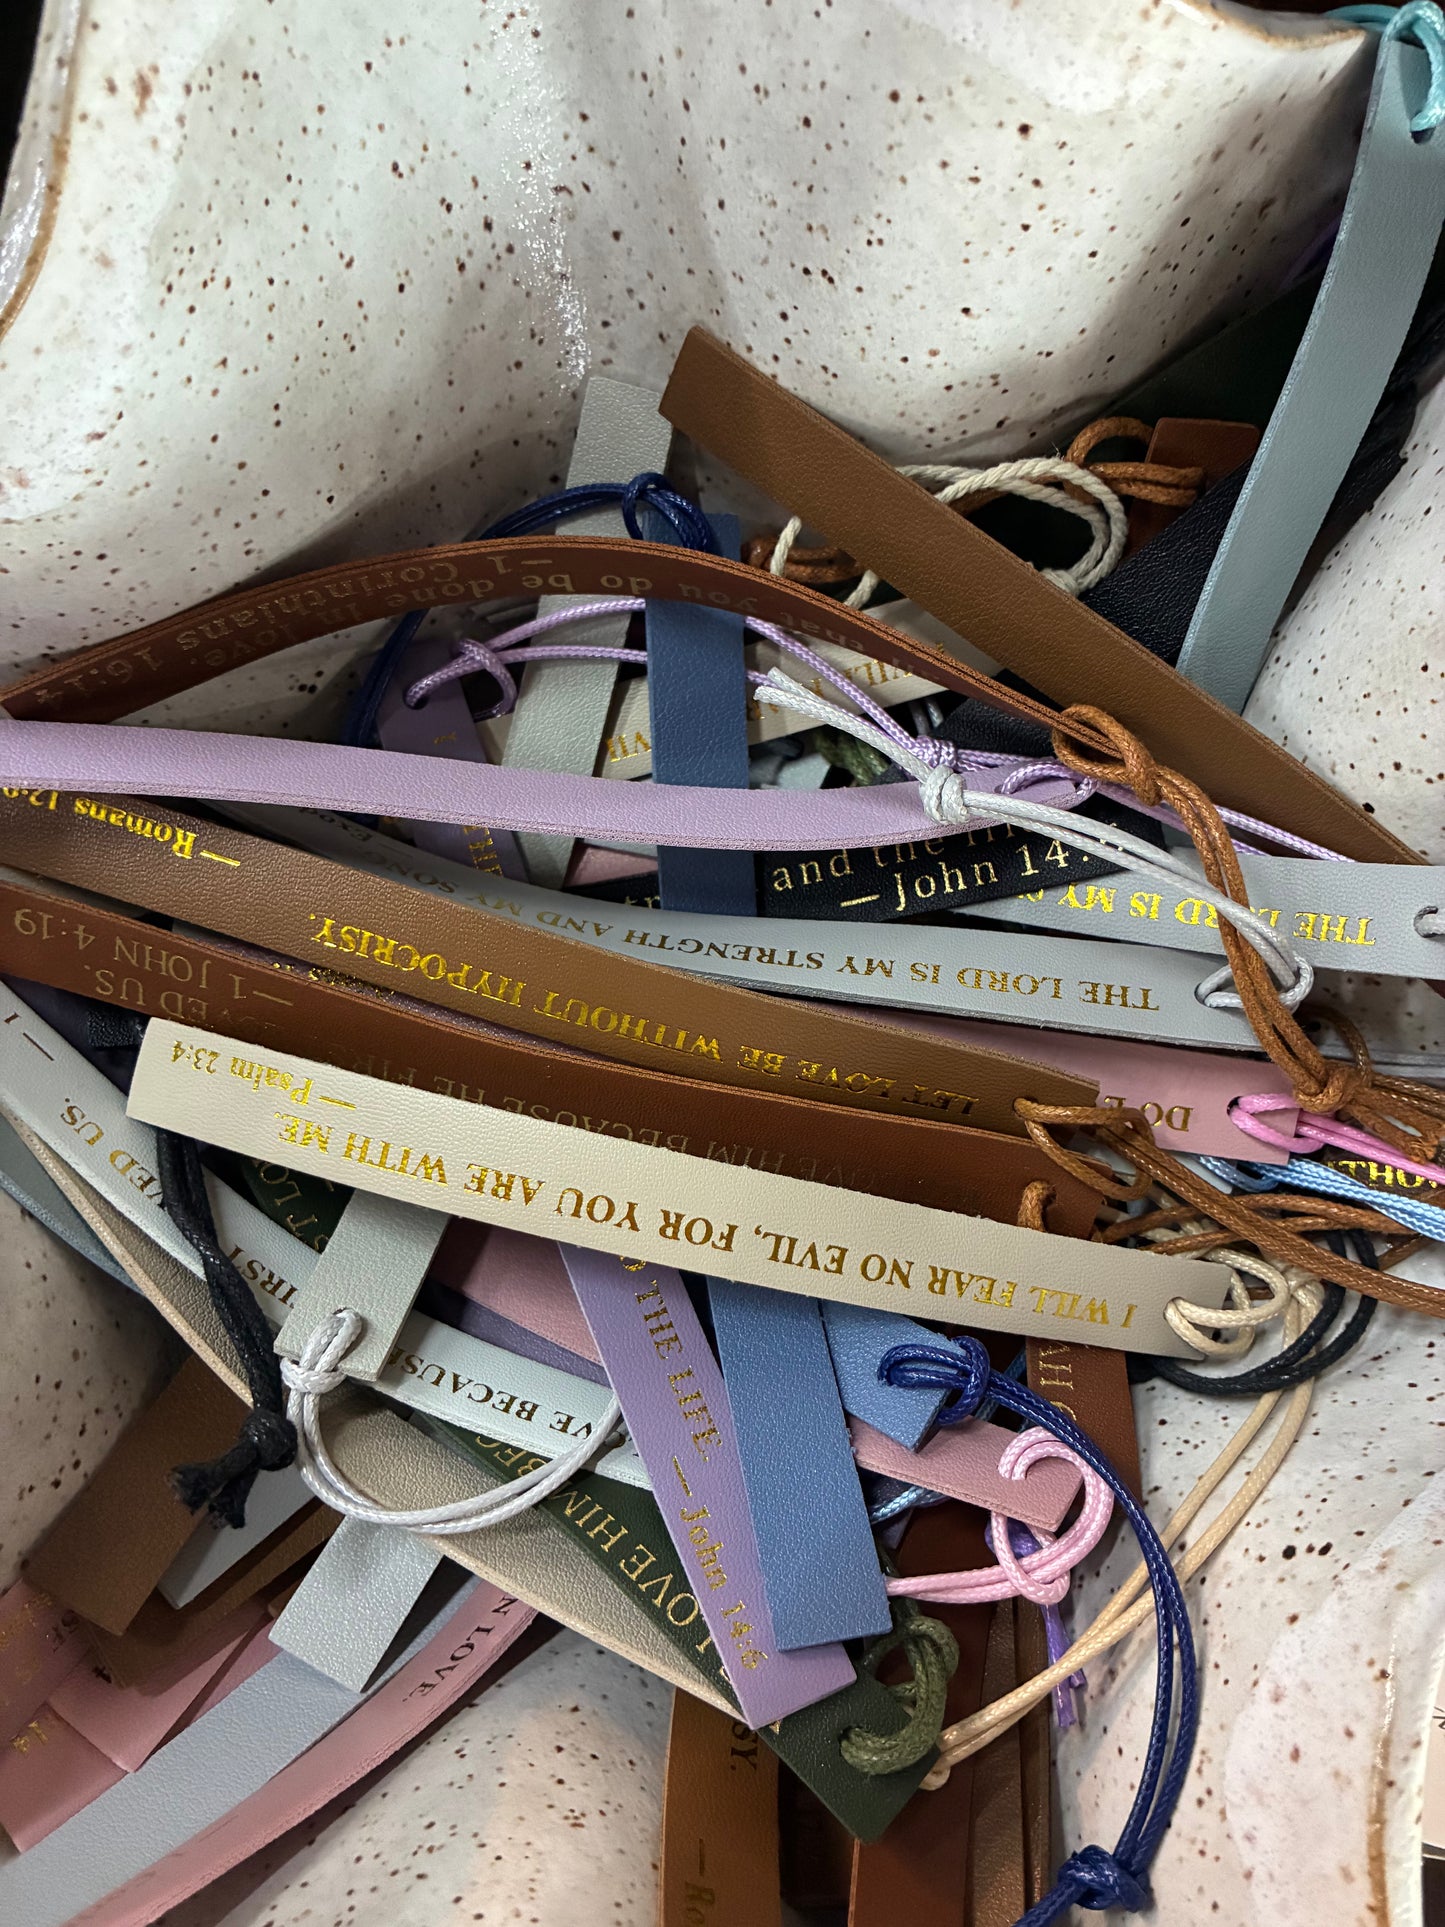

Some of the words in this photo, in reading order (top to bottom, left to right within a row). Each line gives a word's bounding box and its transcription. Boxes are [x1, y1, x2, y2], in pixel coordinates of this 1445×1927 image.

[387, 573, 495, 609] done
[521, 573, 576, 591] be
[600, 574, 652, 593] do
[176, 562, 460, 652] Corinthians
[73, 797, 197, 860] Romans
[773, 850, 852, 892] and
[893, 858, 998, 912] John
[1058, 882, 1115, 914] MY
[1130, 890, 1160, 918] IS
[14, 907, 96, 948] 4:19
[536, 911, 614, 938] AND
[1293, 911, 1376, 946] THE
[113, 935, 212, 985] JOHN
[309, 911, 527, 1007] HYPOCRISY.
[622, 930, 825, 970] STRENGTH
[837, 955, 894, 979] MY
[84, 964, 146, 1005] US.
[909, 962, 941, 984] IS
[956, 966, 1063, 999] LORD
[1078, 981, 1160, 1011] THE
[534, 990, 724, 1063] WITHOUT
[172, 1040, 219, 1075] 23:4
[737, 1045, 789, 1078] BE
[230, 1055, 314, 1105] Psalm
[796, 1058, 897, 1099] LOVE
[903, 1082, 980, 1116] LET
[61, 1098, 105, 1147] US.
[273, 1111, 334, 1155] ME.
[342, 1133, 448, 1188] WITH
[464, 1164, 546, 1207] ARE
[556, 1187, 639, 1233] YOU
[659, 1209, 739, 1252] FOR
[755, 1228, 848, 1274] EVIL,
[860, 1254, 915, 1288] NO
[926, 1266, 1018, 1308] FEAR
[1029, 1287, 1111, 1325] WILL
[1119, 1304, 1140, 1328] I
[634, 1279, 683, 1361] THE
[666, 1365, 723, 1462] LIFE.
[679, 1504, 729, 1592] John
[720, 1600, 769, 1670] 14:6
[402, 1624, 495, 1702] LOVE.
